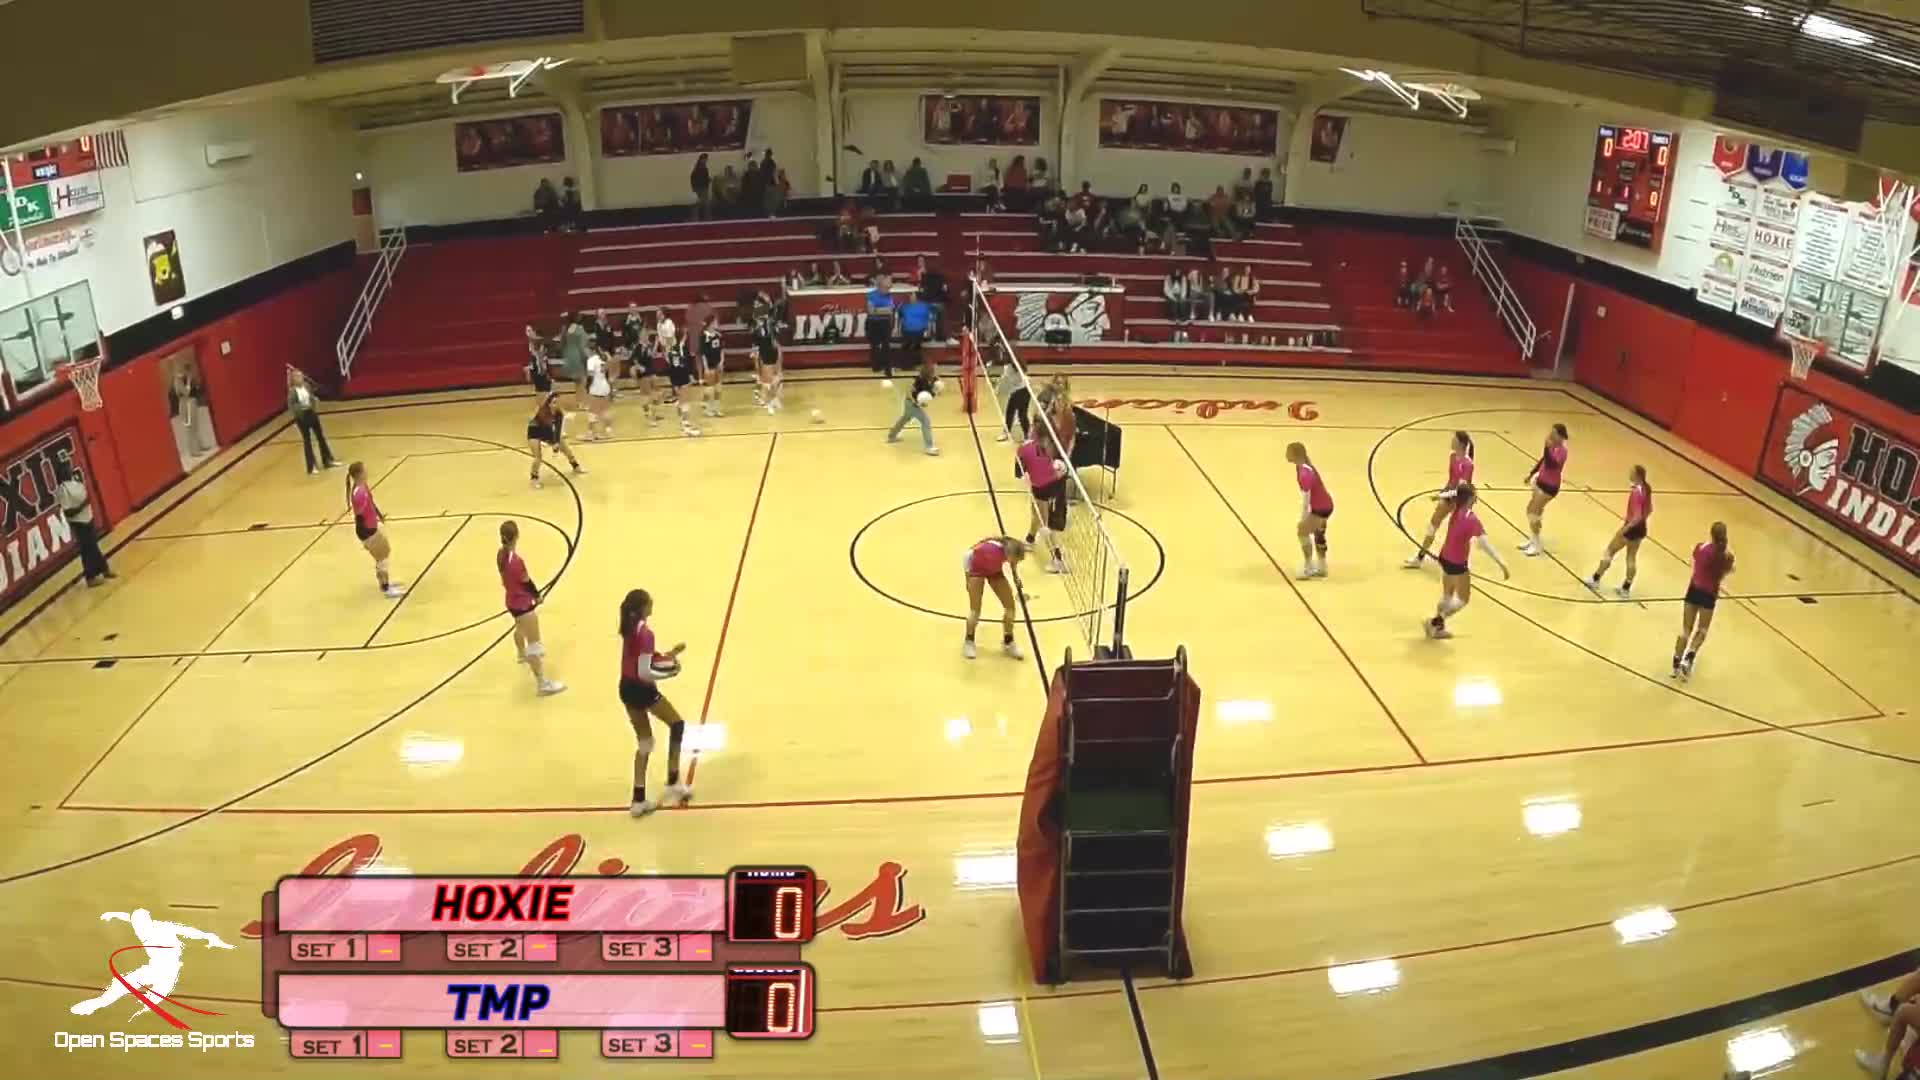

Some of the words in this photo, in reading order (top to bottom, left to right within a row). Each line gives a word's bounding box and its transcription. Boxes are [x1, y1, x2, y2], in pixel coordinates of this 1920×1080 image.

[1603, 138, 1613, 157] 0
[1657, 146, 1668, 166] 0
[1596, 180, 1602, 193] 1
[1623, 185, 1629, 198] 1
[1650, 191, 1658, 206] 0
[1754, 230, 1793, 250] HOXIE
[1840, 424, 1920, 518] HO
